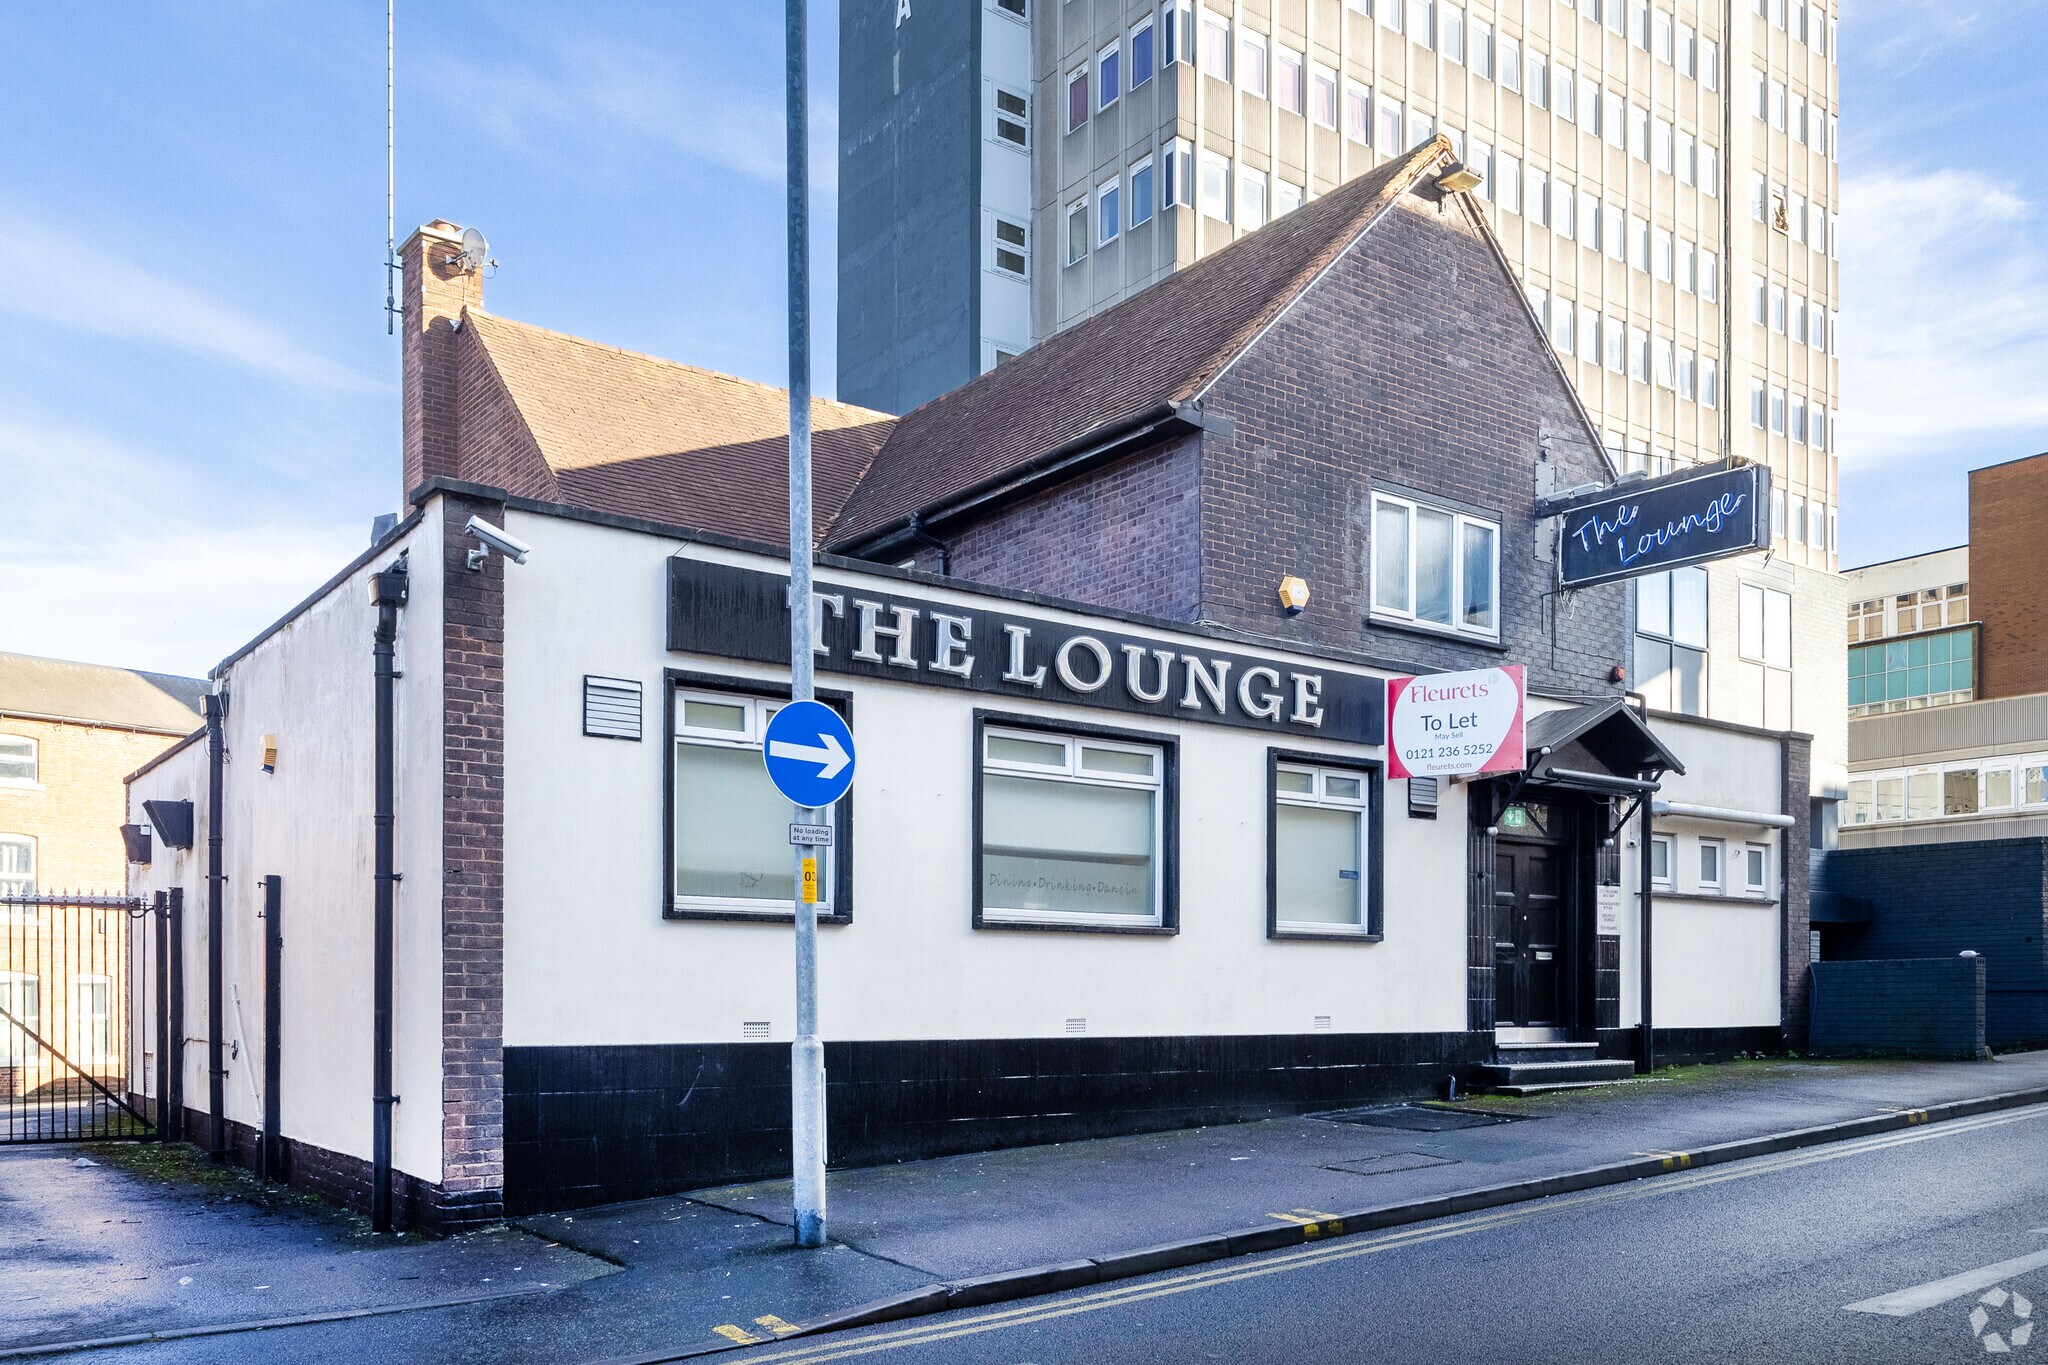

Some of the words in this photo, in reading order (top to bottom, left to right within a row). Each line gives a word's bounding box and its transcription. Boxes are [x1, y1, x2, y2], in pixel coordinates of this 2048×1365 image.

[1572, 504, 1640, 552] The
[1617, 492, 1747, 566] Lounge
[785, 583, 976, 680] THE
[1001, 623, 1326, 728] LOUNGE
[1410, 682, 1489, 704] Fleurets
[1420, 714, 1442, 731] To
[1449, 712, 1478, 729] Let
[1434, 733, 1450, 741] May
[1451, 731, 1464, 739] Sell
[1406, 748, 1435, 760] 0121
[1438, 746, 1460, 758] 236
[1463, 743, 1493, 755] 5252
[1426, 761, 1472, 771] fleurets.com
[804, 828, 829, 836] loading
